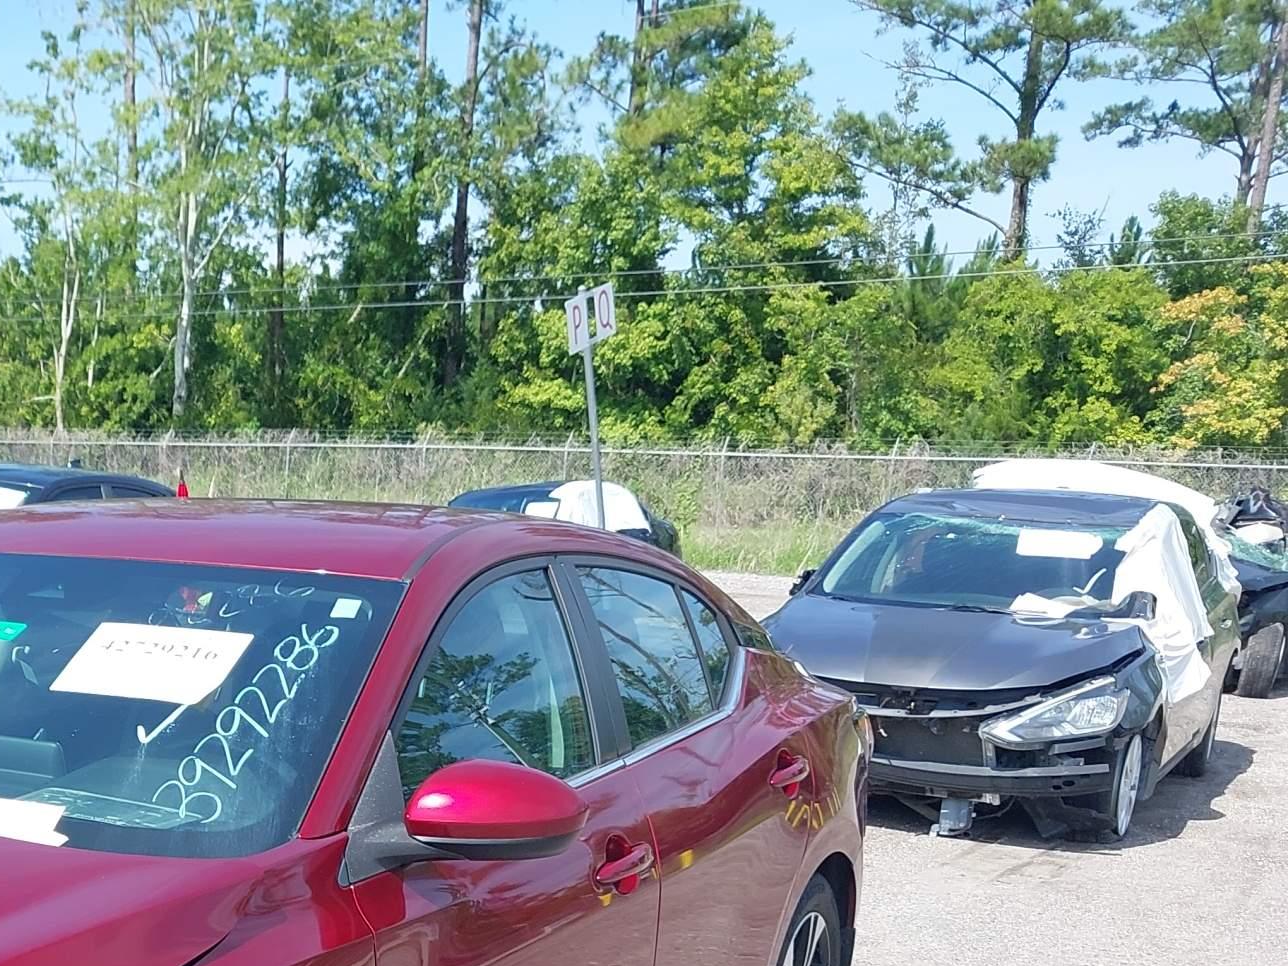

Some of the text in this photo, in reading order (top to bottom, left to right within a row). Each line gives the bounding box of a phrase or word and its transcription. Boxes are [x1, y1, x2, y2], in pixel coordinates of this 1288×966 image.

[573, 290, 613, 345] P Q
[153, 624, 339, 824] 39292286
